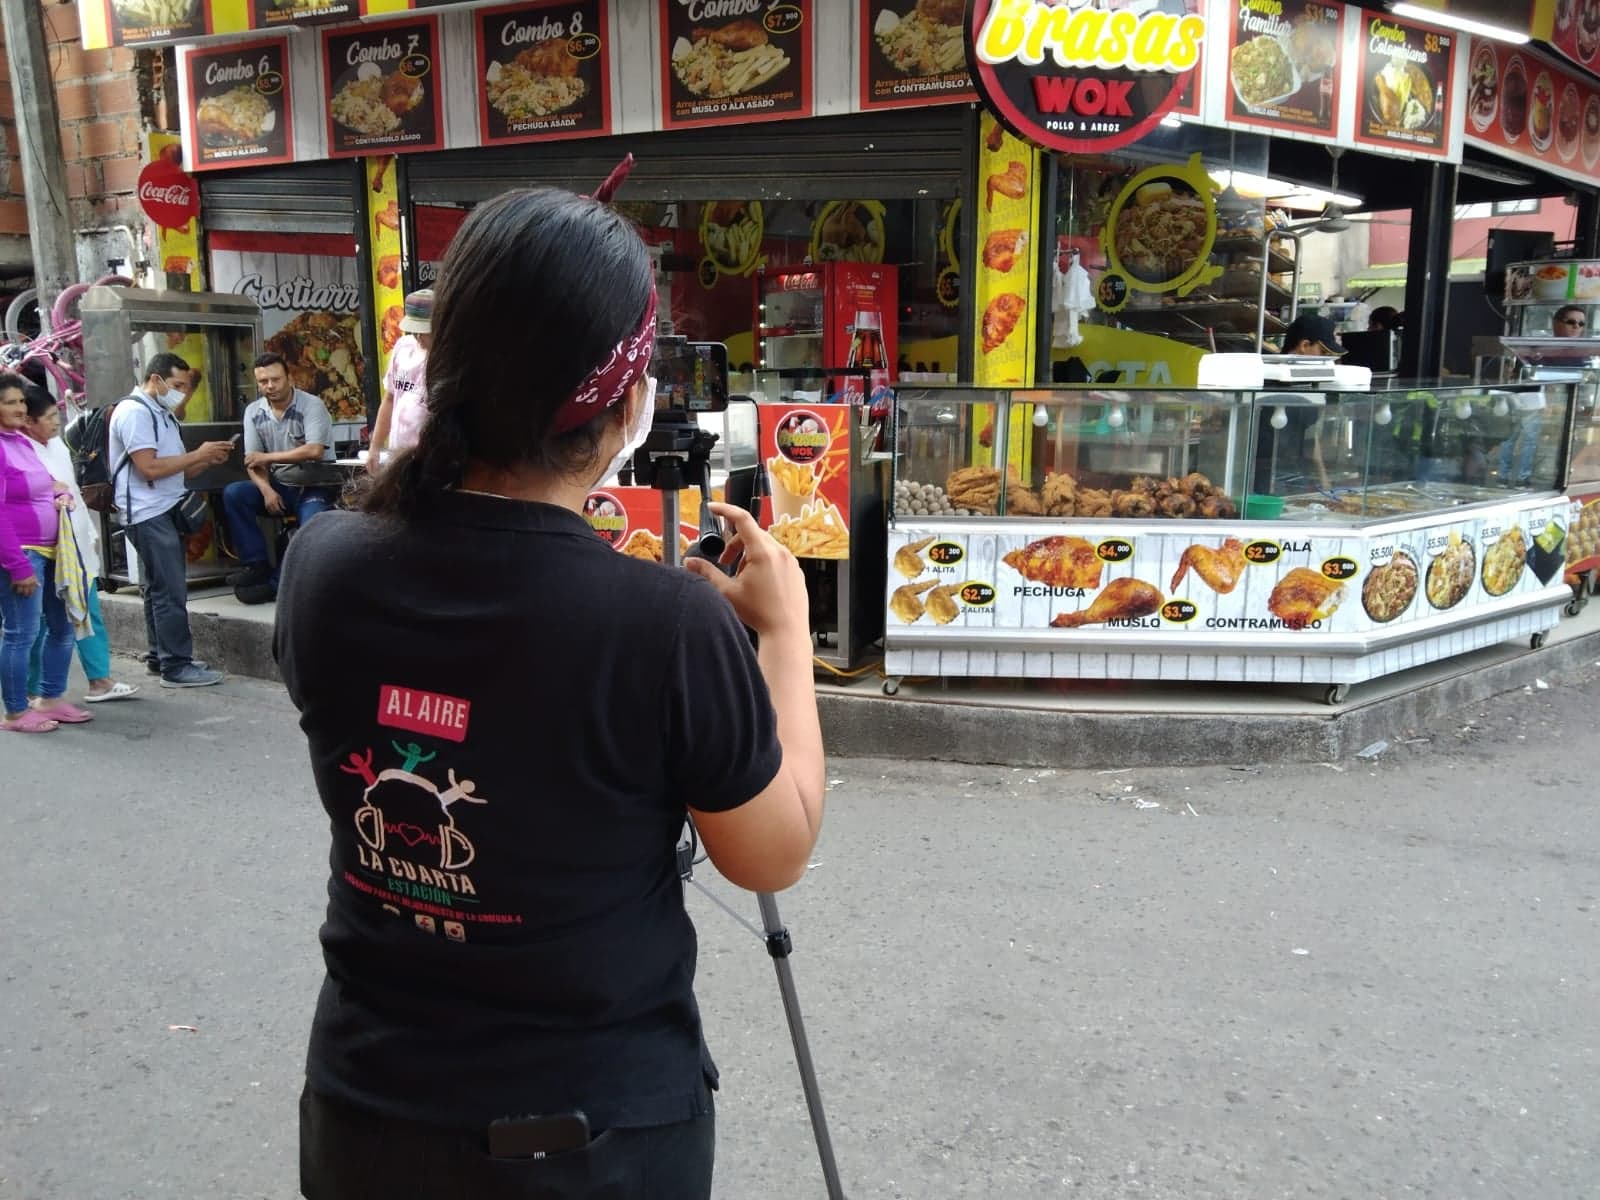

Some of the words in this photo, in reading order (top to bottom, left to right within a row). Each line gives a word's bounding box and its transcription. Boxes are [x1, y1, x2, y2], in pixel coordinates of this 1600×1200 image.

[501, 16, 565, 46] Combo
[569, 11, 583, 36] 8
[1370, 18, 1406, 43] Combo
[346, 38, 403, 65] Combo
[407, 33, 420, 56] 7
[205, 58, 255, 85] Combo
[258, 55, 270, 75] 6
[893, 79, 965, 94] CONTRAMUSLO
[1033, 76, 1137, 117] WOK
[691, 104, 720, 114] MUSLO
[720, 103, 727, 112] O
[728, 102, 746, 111] ALA
[746, 99, 774, 109] ASADO
[512, 120, 549, 131] PECHUGA
[550, 119, 576, 128] ASADA
[1046, 120, 1074, 131] POLLO
[1080, 121, 1087, 131] &
[1091, 122, 1121, 132] ARROZ
[140, 181, 191, 206] Coca-Cola
[790, 446, 813, 457] WOK
[1282, 542, 1312, 552] ALA
[1426, 536, 1449, 549] $5.500
[1097, 544, 1130, 559] $4.000
[1370, 545, 1394, 560] $5.500
[1013, 586, 1086, 598] PECHUGA
[1107, 617, 1161, 628] MUSLO
[1205, 617, 1322, 629] CONTRAMUSLO
[386, 688, 413, 718] AL
[417, 694, 467, 729] AIRE
[357, 844, 384, 872] LA
[388, 856, 477, 896] CUARTA
